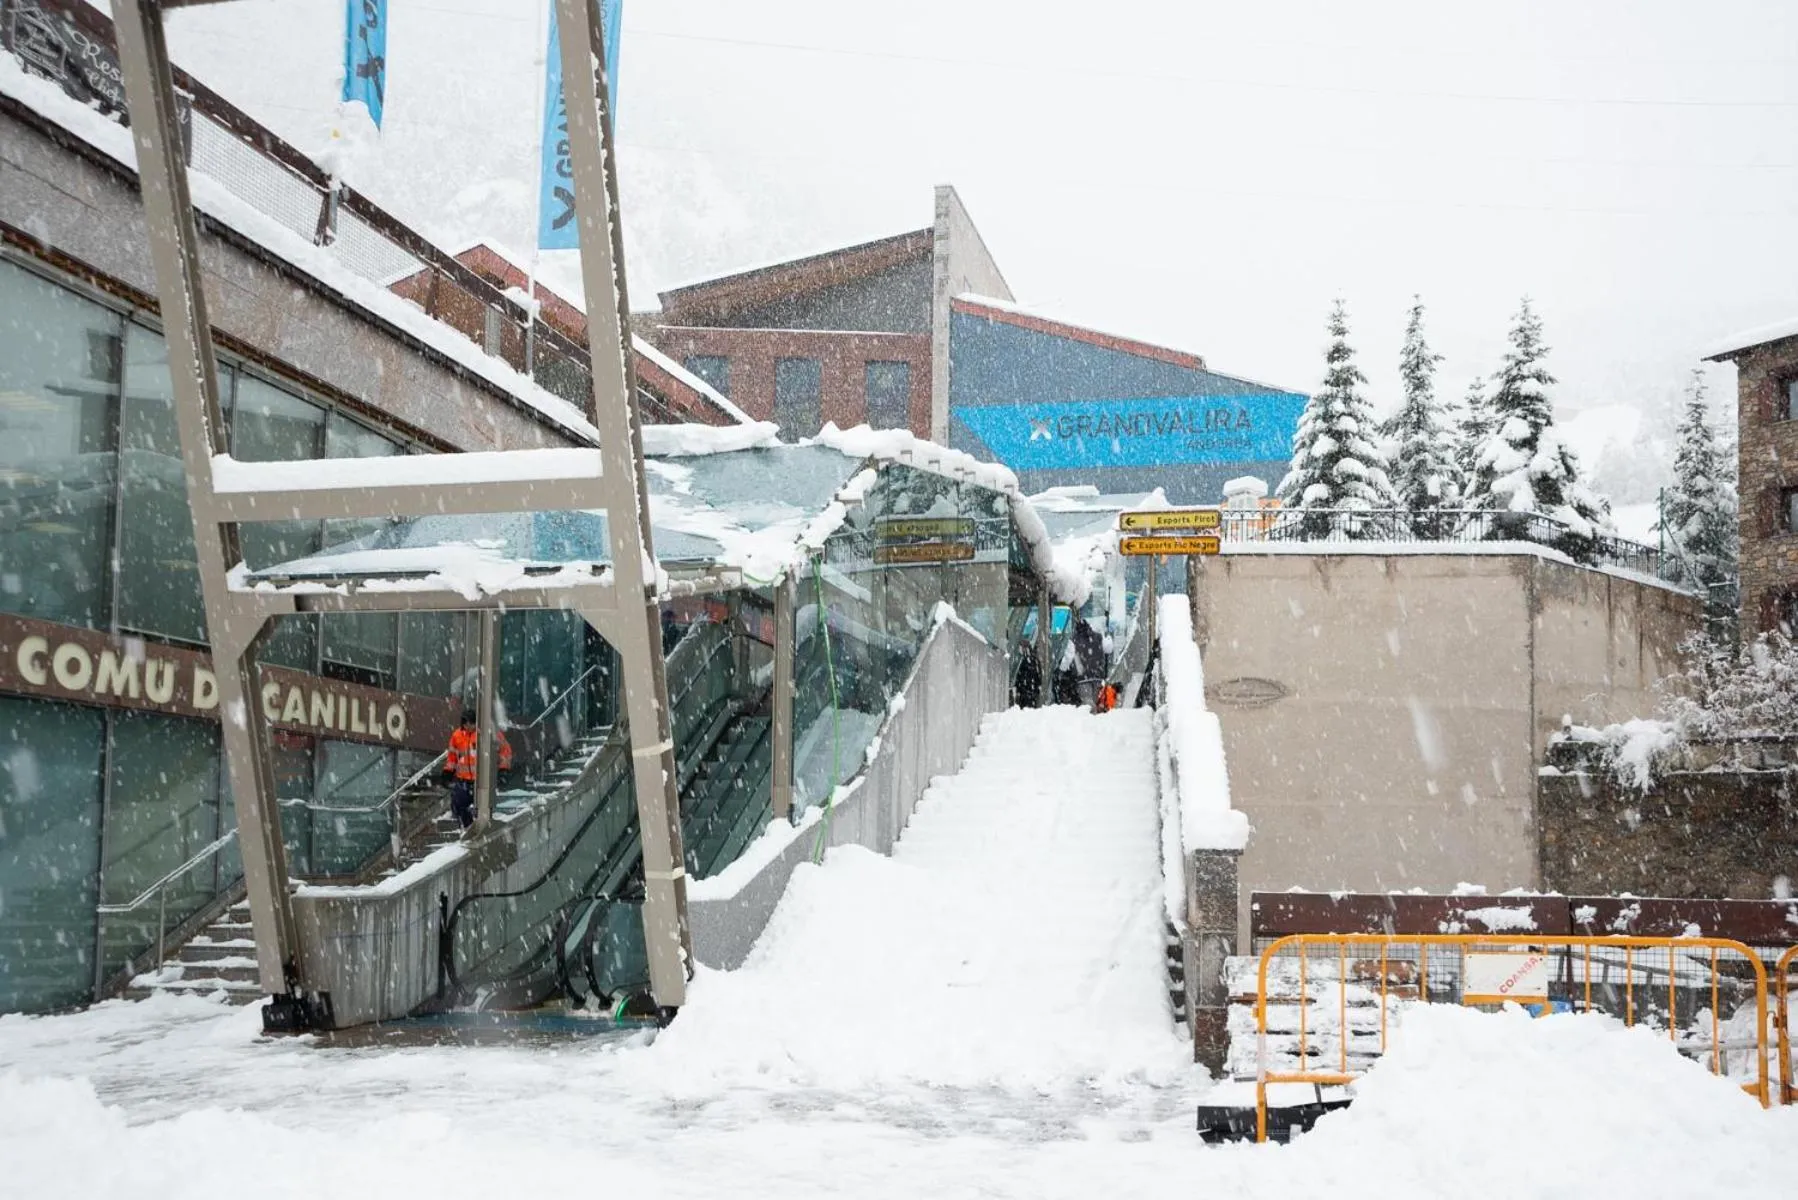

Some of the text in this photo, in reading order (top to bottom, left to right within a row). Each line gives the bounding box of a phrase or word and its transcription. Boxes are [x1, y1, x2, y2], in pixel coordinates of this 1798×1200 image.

[1057, 408, 1250, 439] GRANDVALIRA
[1157, 516, 1190, 524] Esports
[193, 662, 220, 709] D
[262, 681, 406, 741] CANILLO
